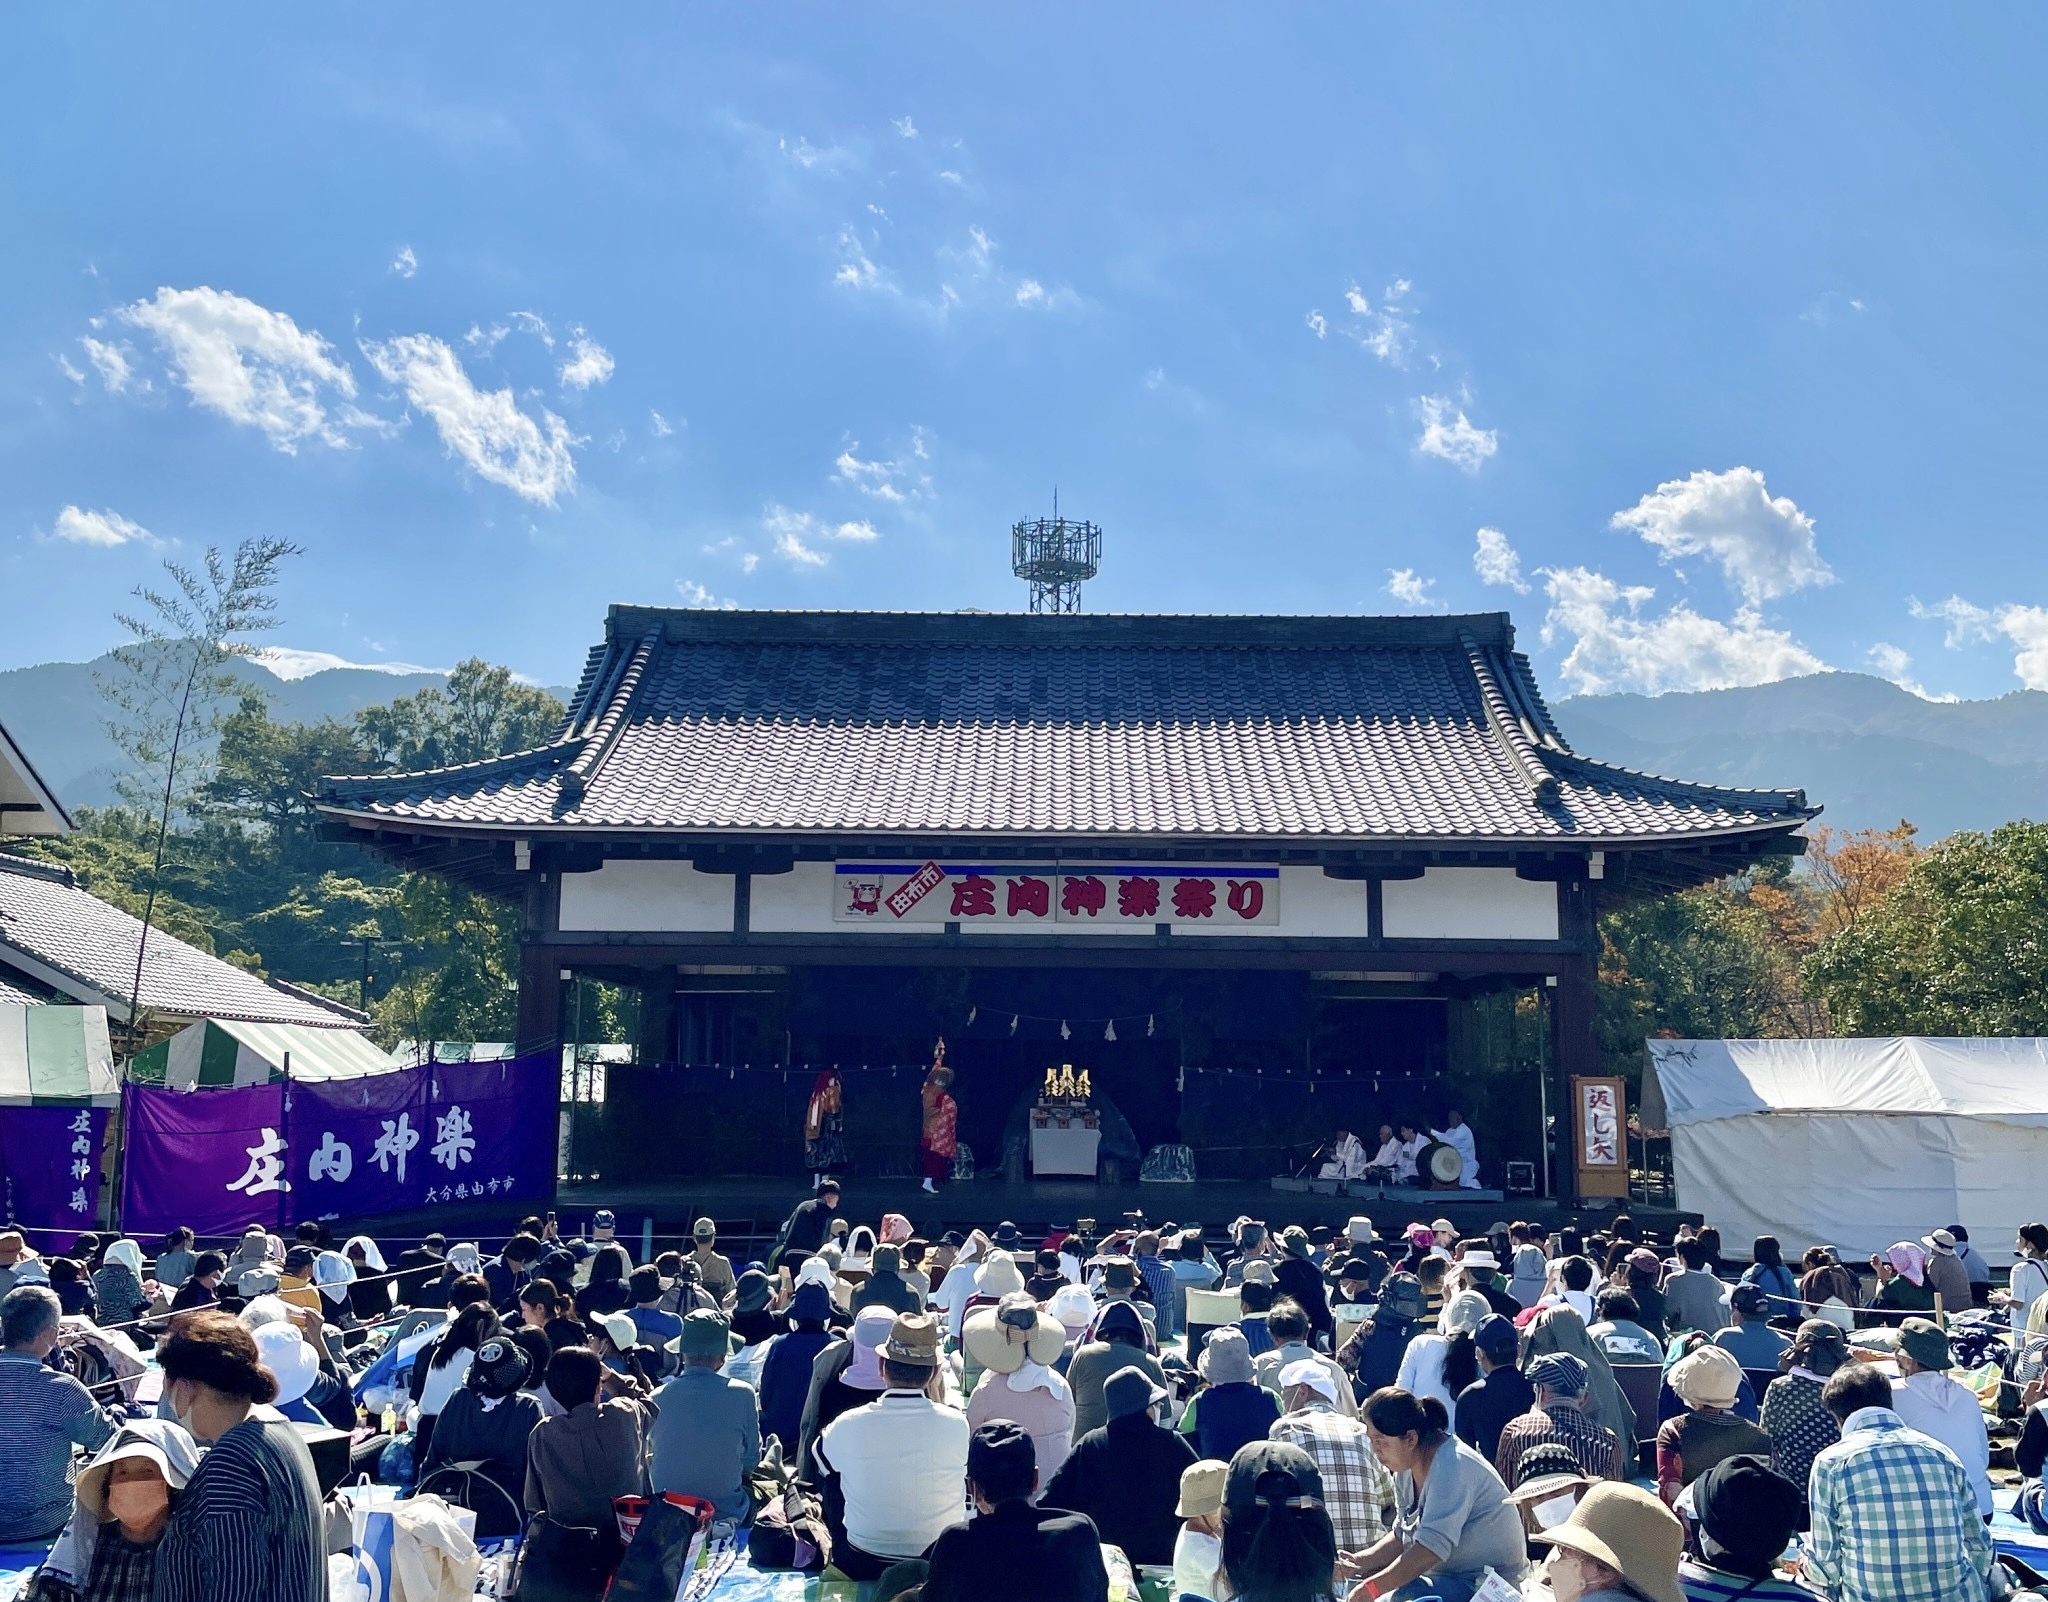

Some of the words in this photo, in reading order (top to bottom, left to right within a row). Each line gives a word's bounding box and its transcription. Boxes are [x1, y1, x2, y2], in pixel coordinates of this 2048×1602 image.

[890, 865, 941, 914] 由布市
[949, 874, 1264, 920] 庄内神楽祭り
[225, 1105, 477, 1197] 庄内神楽
[1588, 1088, 1614, 1161] 返し矢
[66, 1109, 92, 1213] 庄内神楽
[424, 1175, 516, 1203] 大分県由布市
